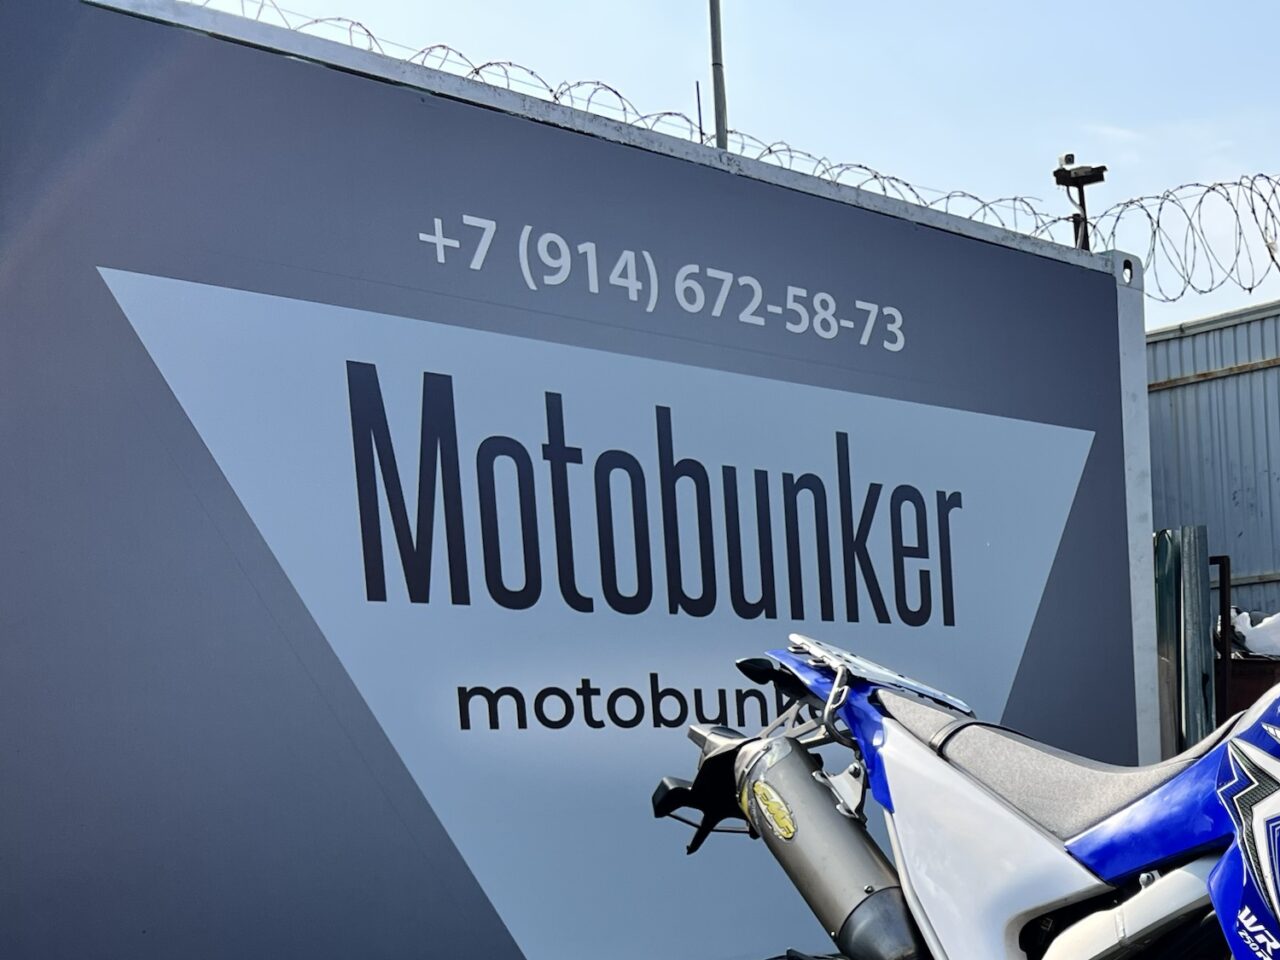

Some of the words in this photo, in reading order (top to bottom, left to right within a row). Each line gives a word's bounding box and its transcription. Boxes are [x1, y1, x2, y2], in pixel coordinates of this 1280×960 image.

[419, 214, 497, 270] +7
[519, 225, 658, 312] (914)
[674, 264, 905, 351] 672-58-73
[346, 360, 962, 627] Motobunker
[457, 672, 823, 730] motobunk
